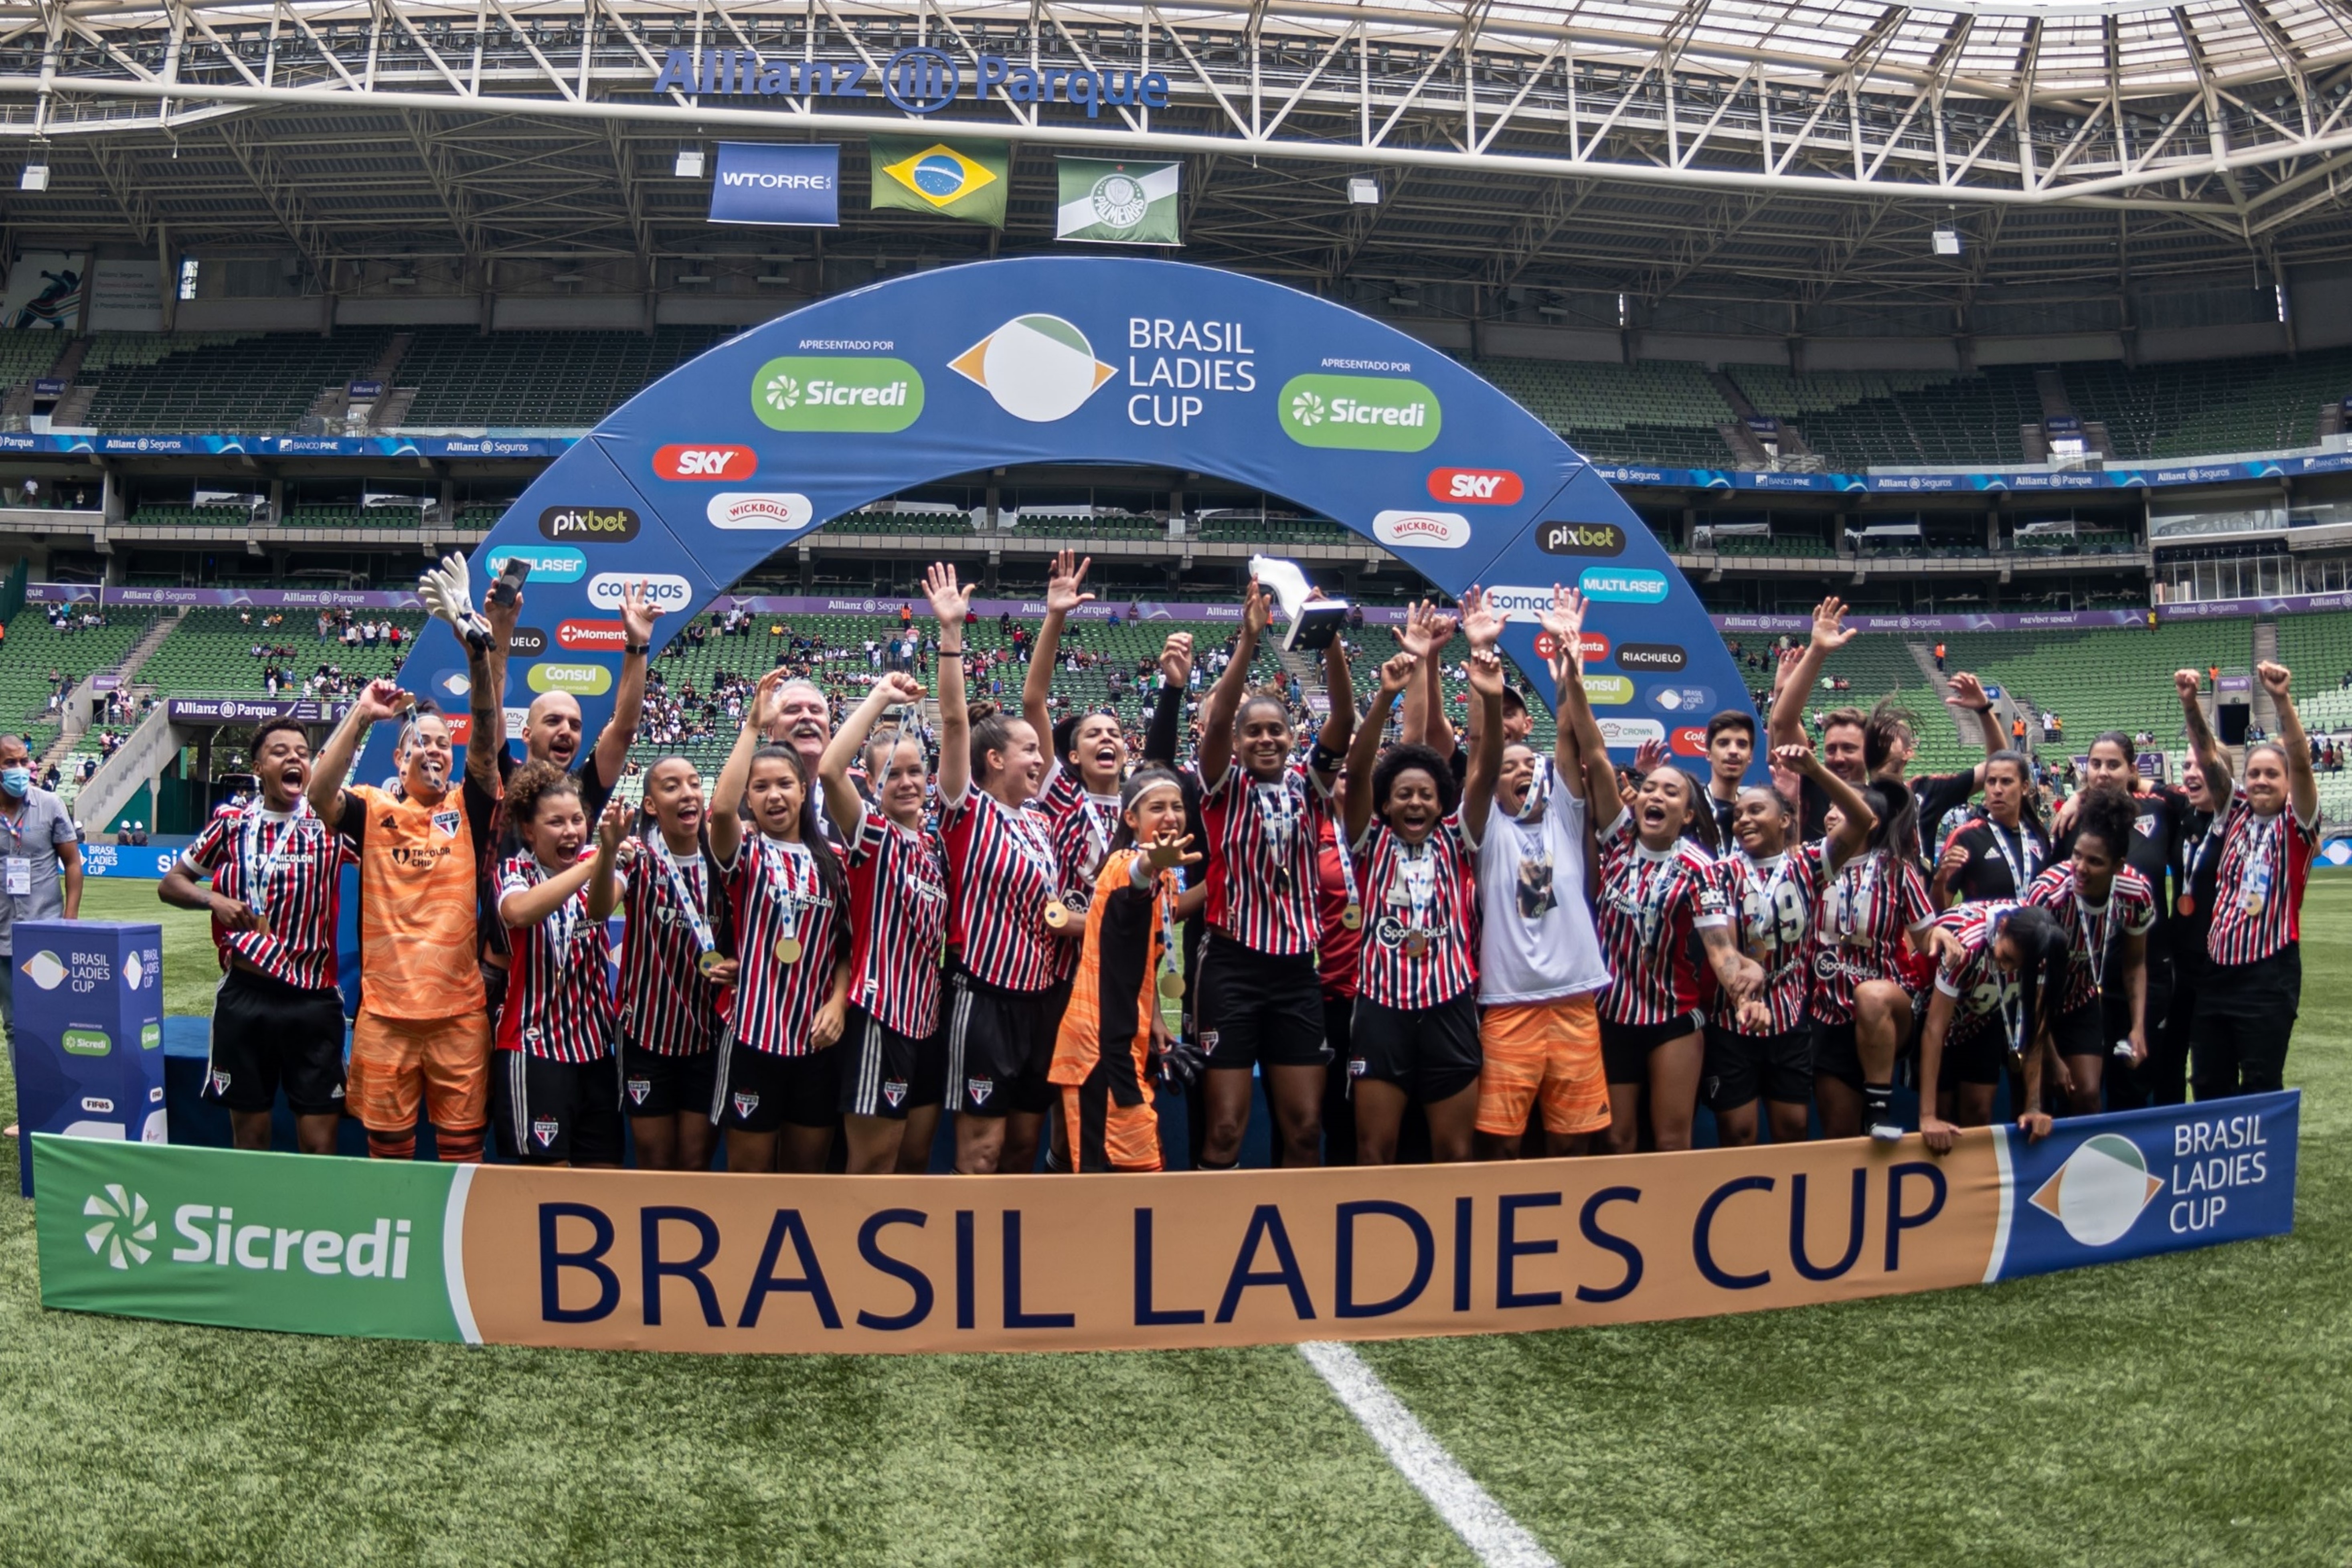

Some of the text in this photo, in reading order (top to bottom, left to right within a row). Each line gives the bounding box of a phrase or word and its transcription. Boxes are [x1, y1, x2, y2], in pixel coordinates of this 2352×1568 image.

[654, 50, 1169, 118] Allianz Parque
[723, 172, 824, 189] WTORRE
[1094, 196, 1144, 225] PALMEIRAS
[1129, 318, 1254, 354] BRASIL
[799, 340, 894, 350] APRESENTADO POR
[1321, 358, 1411, 372] APRESENTADO POR
[1129, 356, 1256, 392] LADIES
[805, 381, 907, 407] Sicredi
[1127, 395, 1203, 427] CUP
[1330, 399, 1425, 427] Sicredi
[4, 437, 34, 449] Parque
[106, 439, 181, 451] Allianz Seguros
[293, 442, 338, 450] BANCO PINE
[447, 442, 528, 453] Allianz Seguros
[677, 451, 735, 474] SKY
[2316, 458, 2339, 467] BANCO
[1629, 470, 1660, 480] Seguros
[2016, 475, 2092, 486] Allianz Parque
[2158, 469, 2230, 482] Allianz Seguros
[1449, 474, 1501, 498] SKY
[1769, 477, 1793, 486] BANCO
[1878, 479, 1952, 488] Allianz Seguros
[729, 503, 788, 518] WICKBOLD
[553, 510, 627, 536] pixbet
[1393, 522, 1448, 537] WICKBOLD
[1549, 526, 1614, 549] pixbet
[122, 591, 197, 602] Allianz Seguros
[283, 592, 364, 605] Allianz Parque
[2309, 598, 2340, 607] Allianz
[828, 600, 862, 610] Allianz
[1077, 605, 1111, 615] Parque
[2168, 604, 2239, 614] Allianz Seguros
[1206, 607, 1239, 616] Allianz
[1725, 618, 1801, 628] Allianz Parque
[1869, 618, 1941, 627] Allianz Seguros
[2020, 615, 2048, 624] PREVENT
[577, 629, 628, 640] Moment
[1623, 652, 1681, 663] RIACHUELO
[546, 666, 596, 682] Consul
[1582, 679, 1620, 691] onsul
[176, 701, 277, 718] Allianz Parque
[1683, 702, 1696, 710] CUP
[1622, 728, 1652, 736] CROWN
[435, 812, 458, 822] SPFC
[89, 845, 117, 855] BRASIL
[88, 856, 118, 865] LADIES
[412, 859, 432, 867] CHIP
[88, 866, 105, 875] CUP
[72, 953, 110, 967] BRASIL
[144, 949, 159, 961] BRASIL
[72, 967, 110, 980] LADIES
[144, 962, 159, 974] LADIES
[72, 979, 95, 992] CUP
[144, 976, 154, 988] CUP
[77, 1038, 106, 1048] Sicredi
[2174, 1115, 2267, 1157] BRASIL
[2172, 1152, 2267, 1196] LADIES
[2170, 1196, 2227, 1234] CUP
[173, 1204, 411, 1279] Sicredi
[539, 1161, 1947, 1332] BRASIL LADIES CUP
